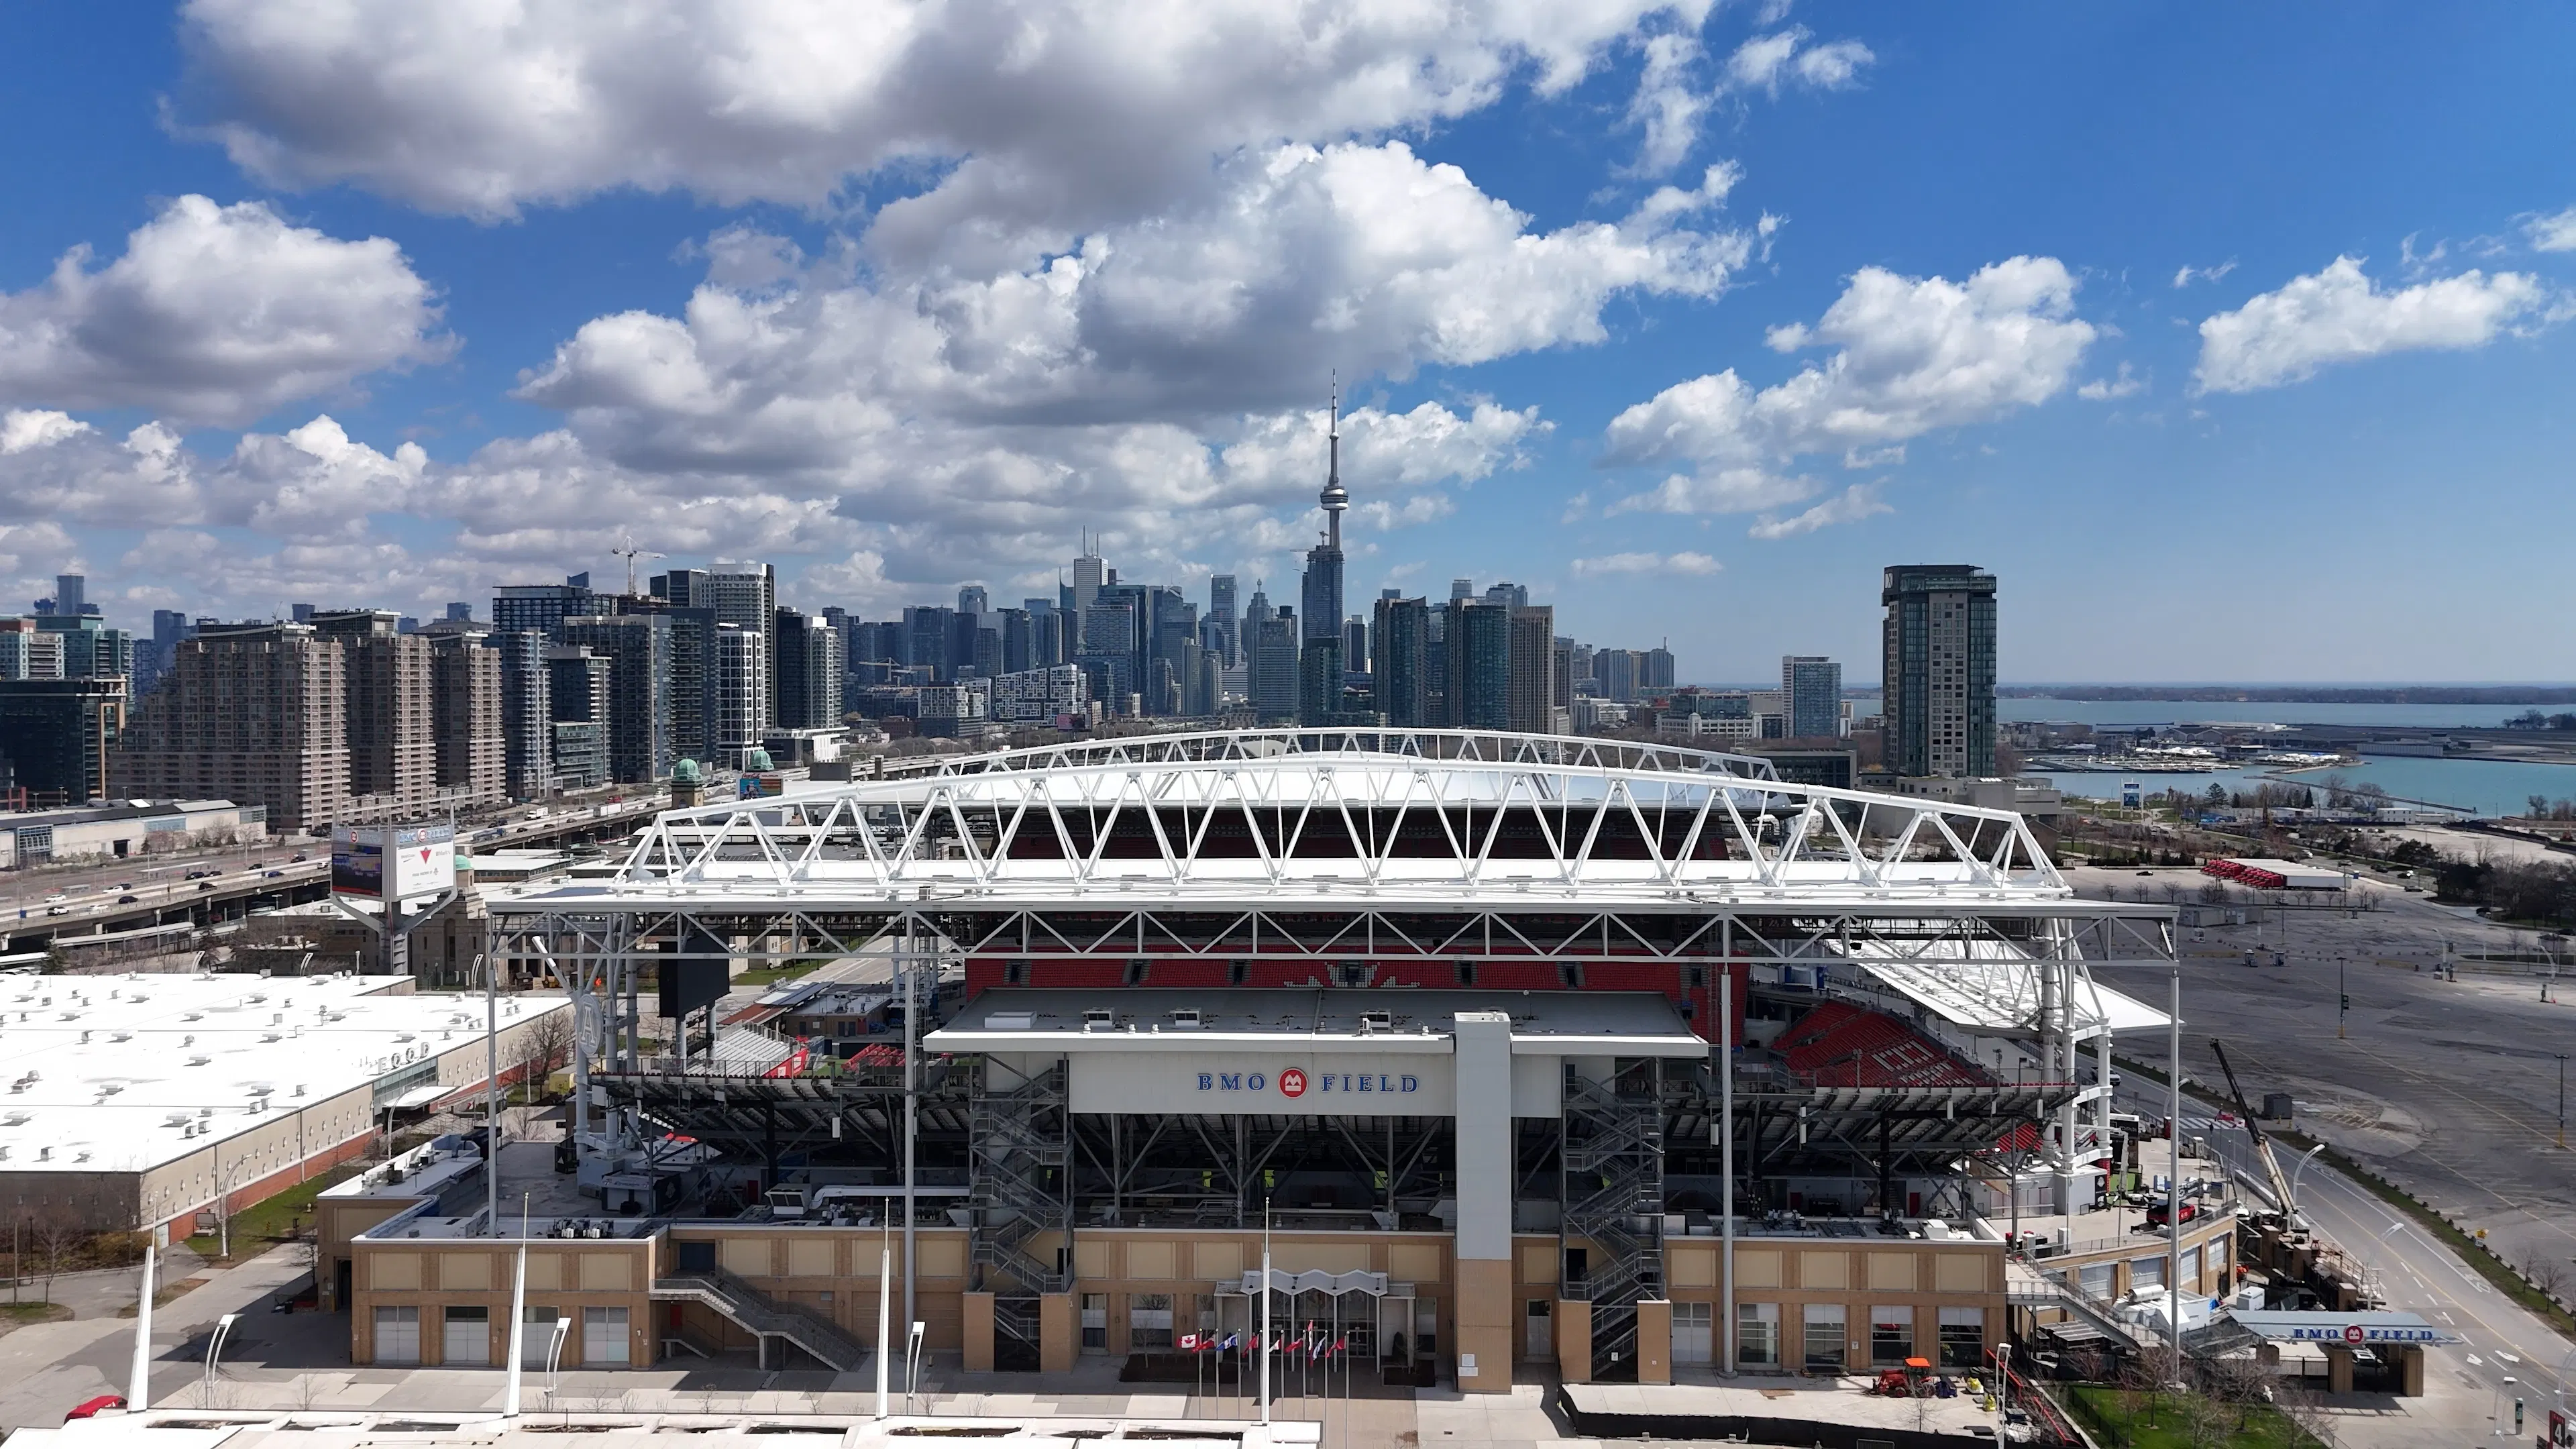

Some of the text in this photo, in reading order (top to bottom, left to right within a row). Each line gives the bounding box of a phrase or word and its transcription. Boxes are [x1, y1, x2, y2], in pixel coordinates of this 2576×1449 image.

[579, 1002, 597, 1048] A
[378, 1042, 430, 1074] FOOD
[1197, 1073, 1419, 1093] BMO FIELD
[2292, 1328, 2433, 1340] BMO FIELD
[2555, 1423, 2563, 1444] 4
